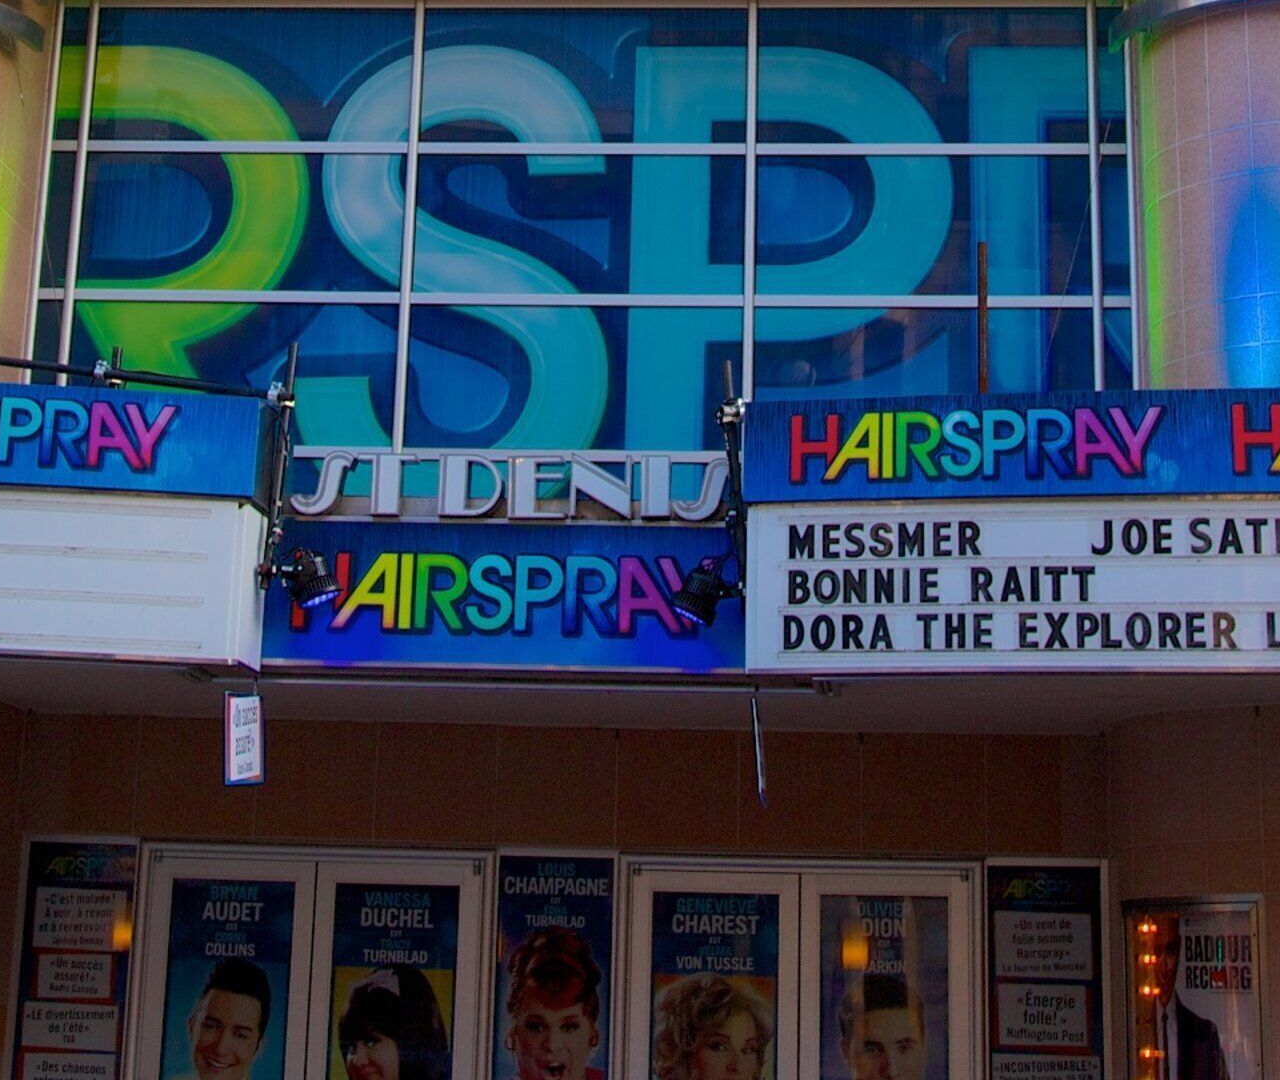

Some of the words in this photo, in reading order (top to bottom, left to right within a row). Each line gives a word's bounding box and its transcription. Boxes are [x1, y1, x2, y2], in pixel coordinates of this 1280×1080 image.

[788, 405, 1163, 484] HAIRSPRAY
[289, 450, 420, 518] ST
[437, 452, 730, 520] DENIS
[788, 521, 982, 560] MESSMER
[1090, 518, 1174, 556] JOE
[787, 567, 940, 605] BONNIE
[969, 565, 1097, 603] RAITT
[782, 614, 893, 651] DORA
[916, 613, 994, 650] THE
[1018, 611, 1239, 650] EXPLORER
[538, 863, 576, 877] LOUIS
[211, 885, 258, 901] BRYAN
[504, 876, 609, 896] CHAMPAGNE
[364, 892, 431, 908] VANESSA
[202, 902, 264, 921] AUDET
[360, 908, 434, 929] DUCHEL
[525, 914, 585, 929] TURNBLAD
[672, 915, 760, 936] CHAREST
[863, 917, 906, 938] DION
[205, 942, 256, 957] COLLINS
[363, 948, 428, 964] TURNBLAD
[676, 956, 702, 970] VON
[707, 956, 754, 971] TUSSLE
[863, 960, 906, 974] ARKIN
[1007, 1027, 1058, 1042] Huffington
[1062, 1029, 1084, 1042] Post
